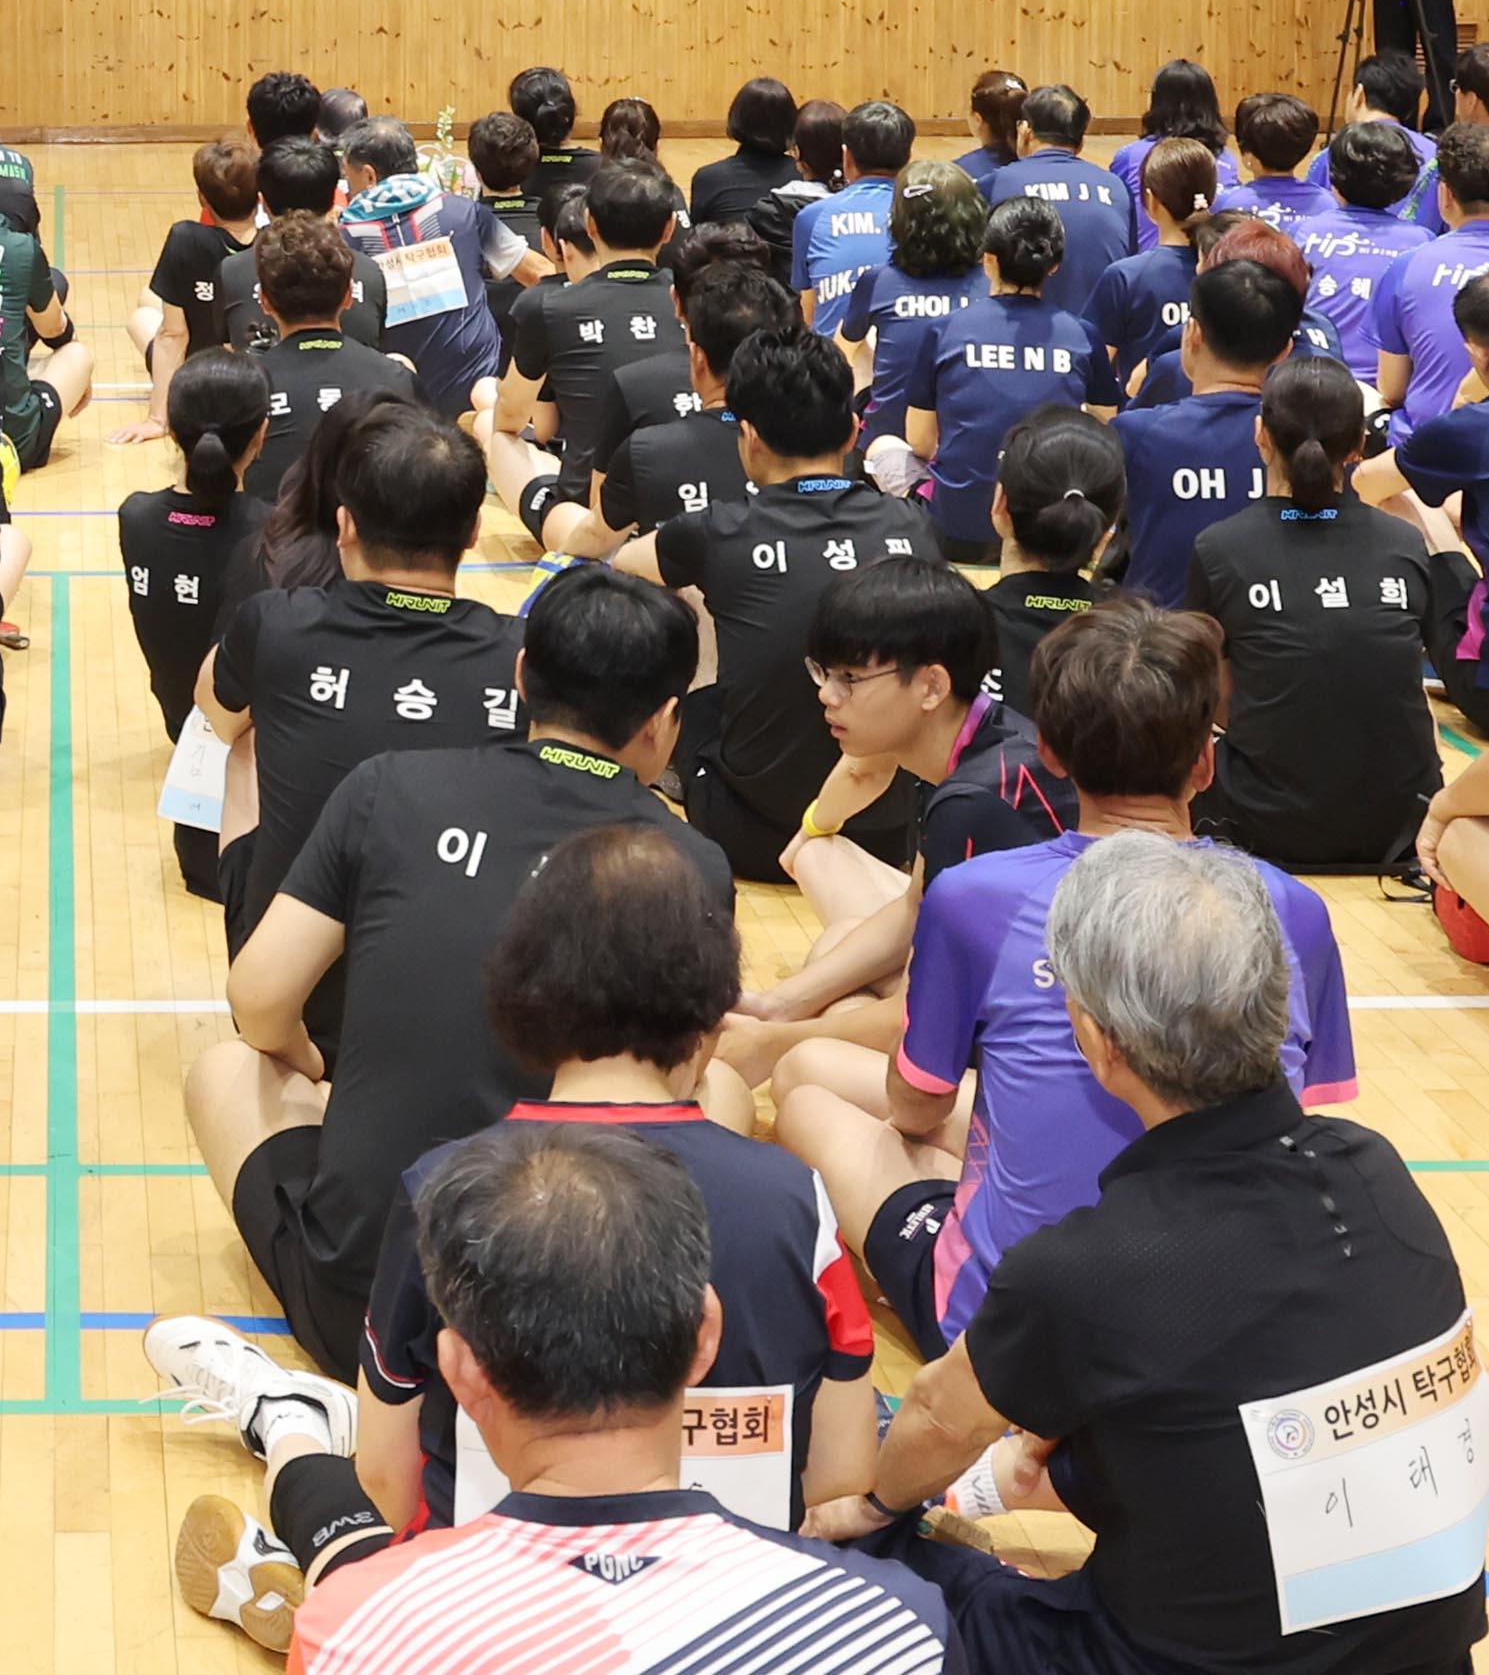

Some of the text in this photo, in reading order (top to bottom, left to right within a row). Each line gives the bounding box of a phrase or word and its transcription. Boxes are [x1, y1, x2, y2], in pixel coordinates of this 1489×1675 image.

[894, 294, 951, 318] CHOI
[965, 343, 1073, 374] LEE N B
[1172, 468, 1226, 500] OH
[1321, 1384, 1412, 1446] 안성시
